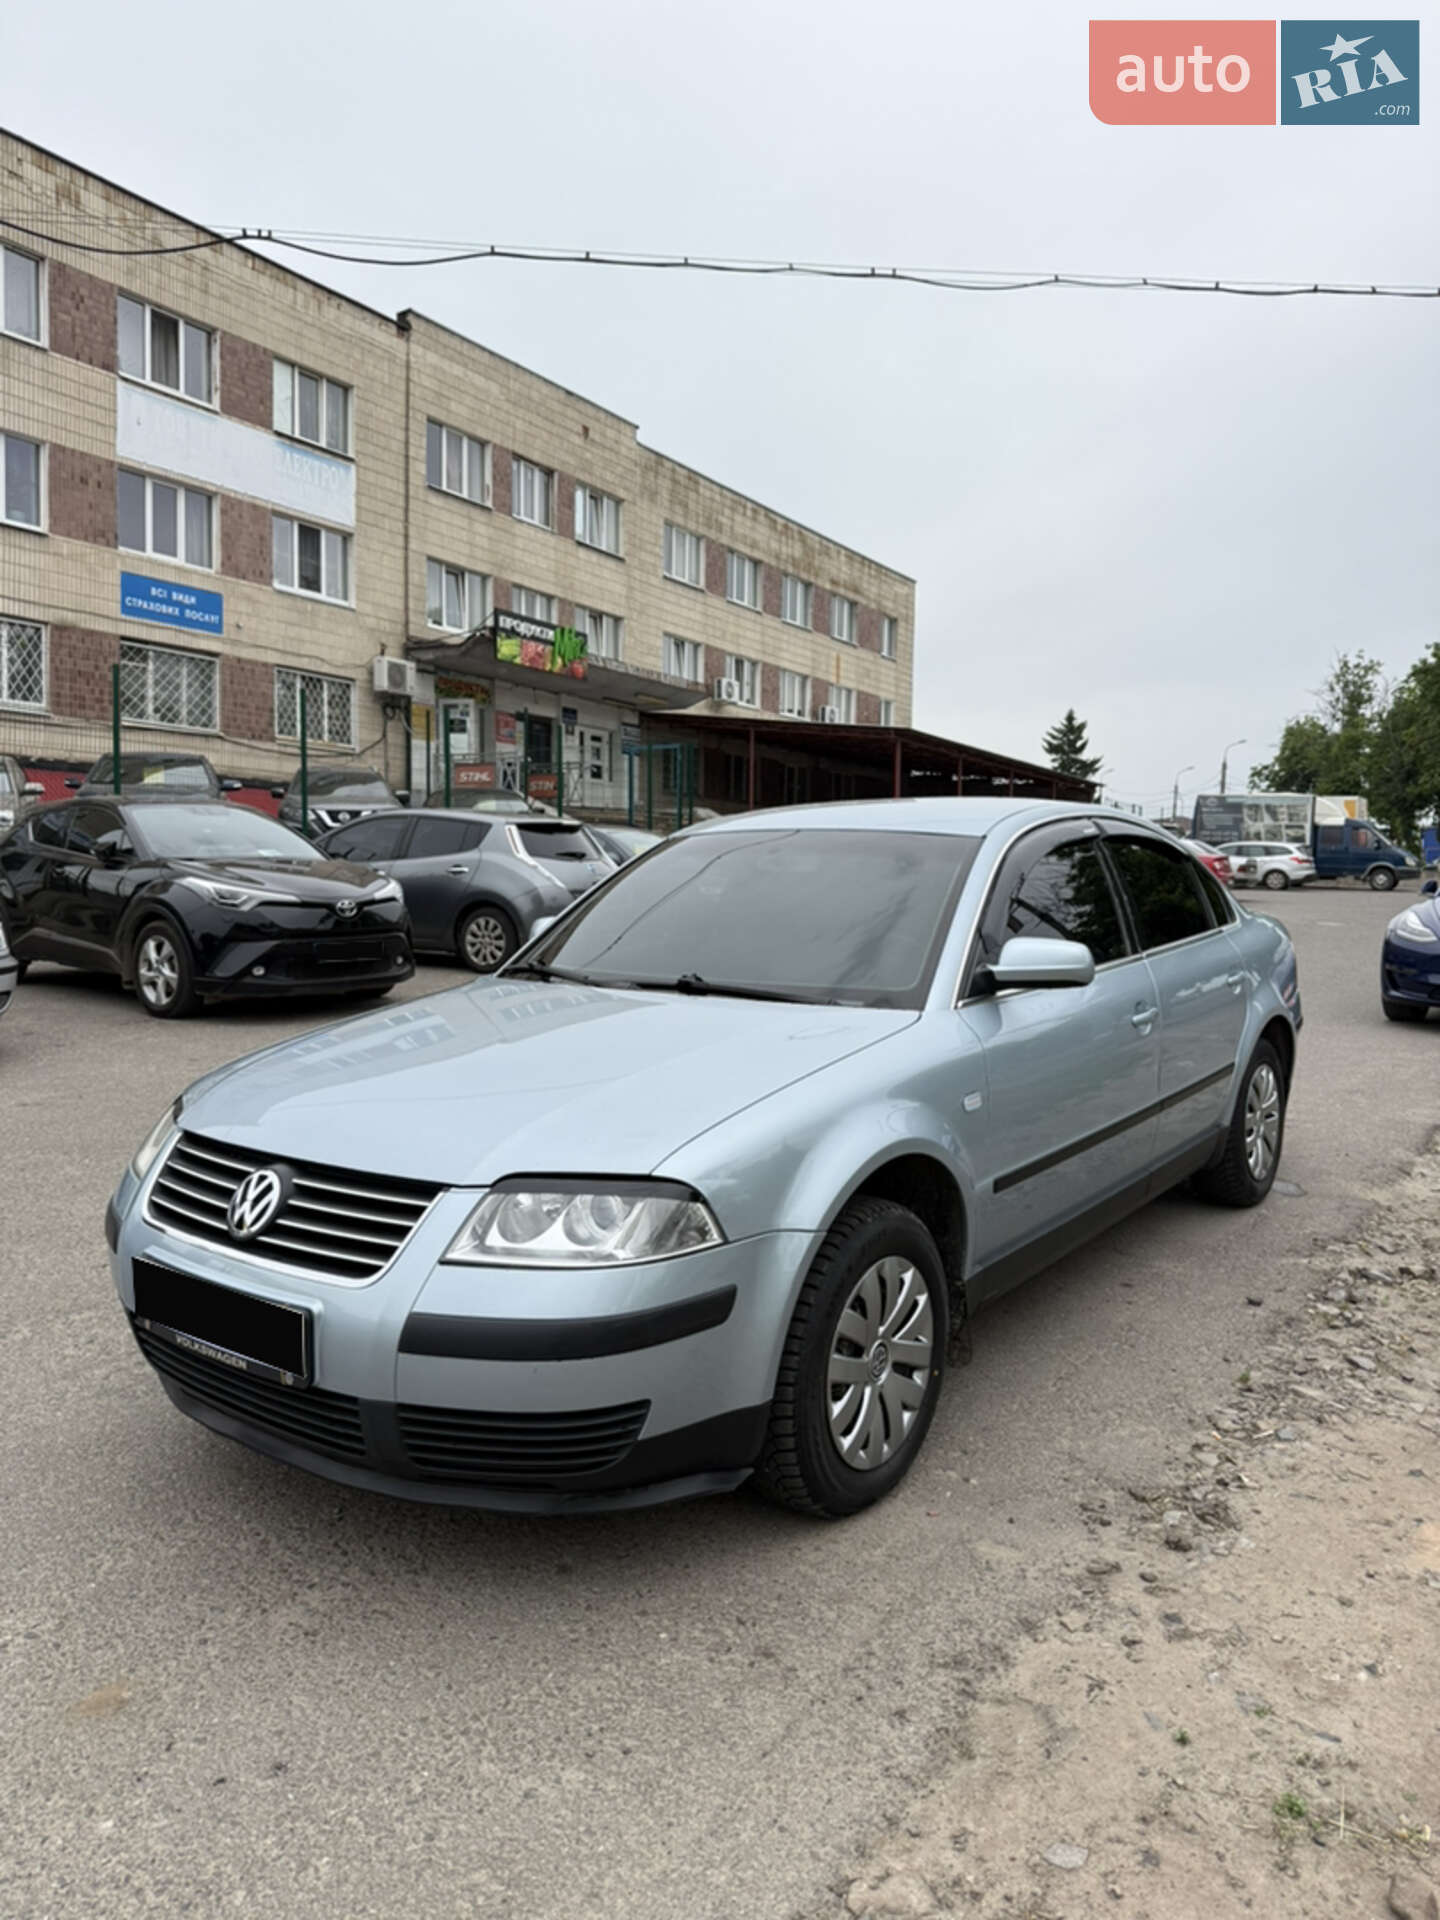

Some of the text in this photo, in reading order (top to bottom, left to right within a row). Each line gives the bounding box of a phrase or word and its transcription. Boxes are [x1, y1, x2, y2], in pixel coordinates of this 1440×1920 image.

[150, 586, 197, 605] ВСІ ВИДИ
[125, 596, 220, 625] СТРАХОВИХ ПОСЛУГ
